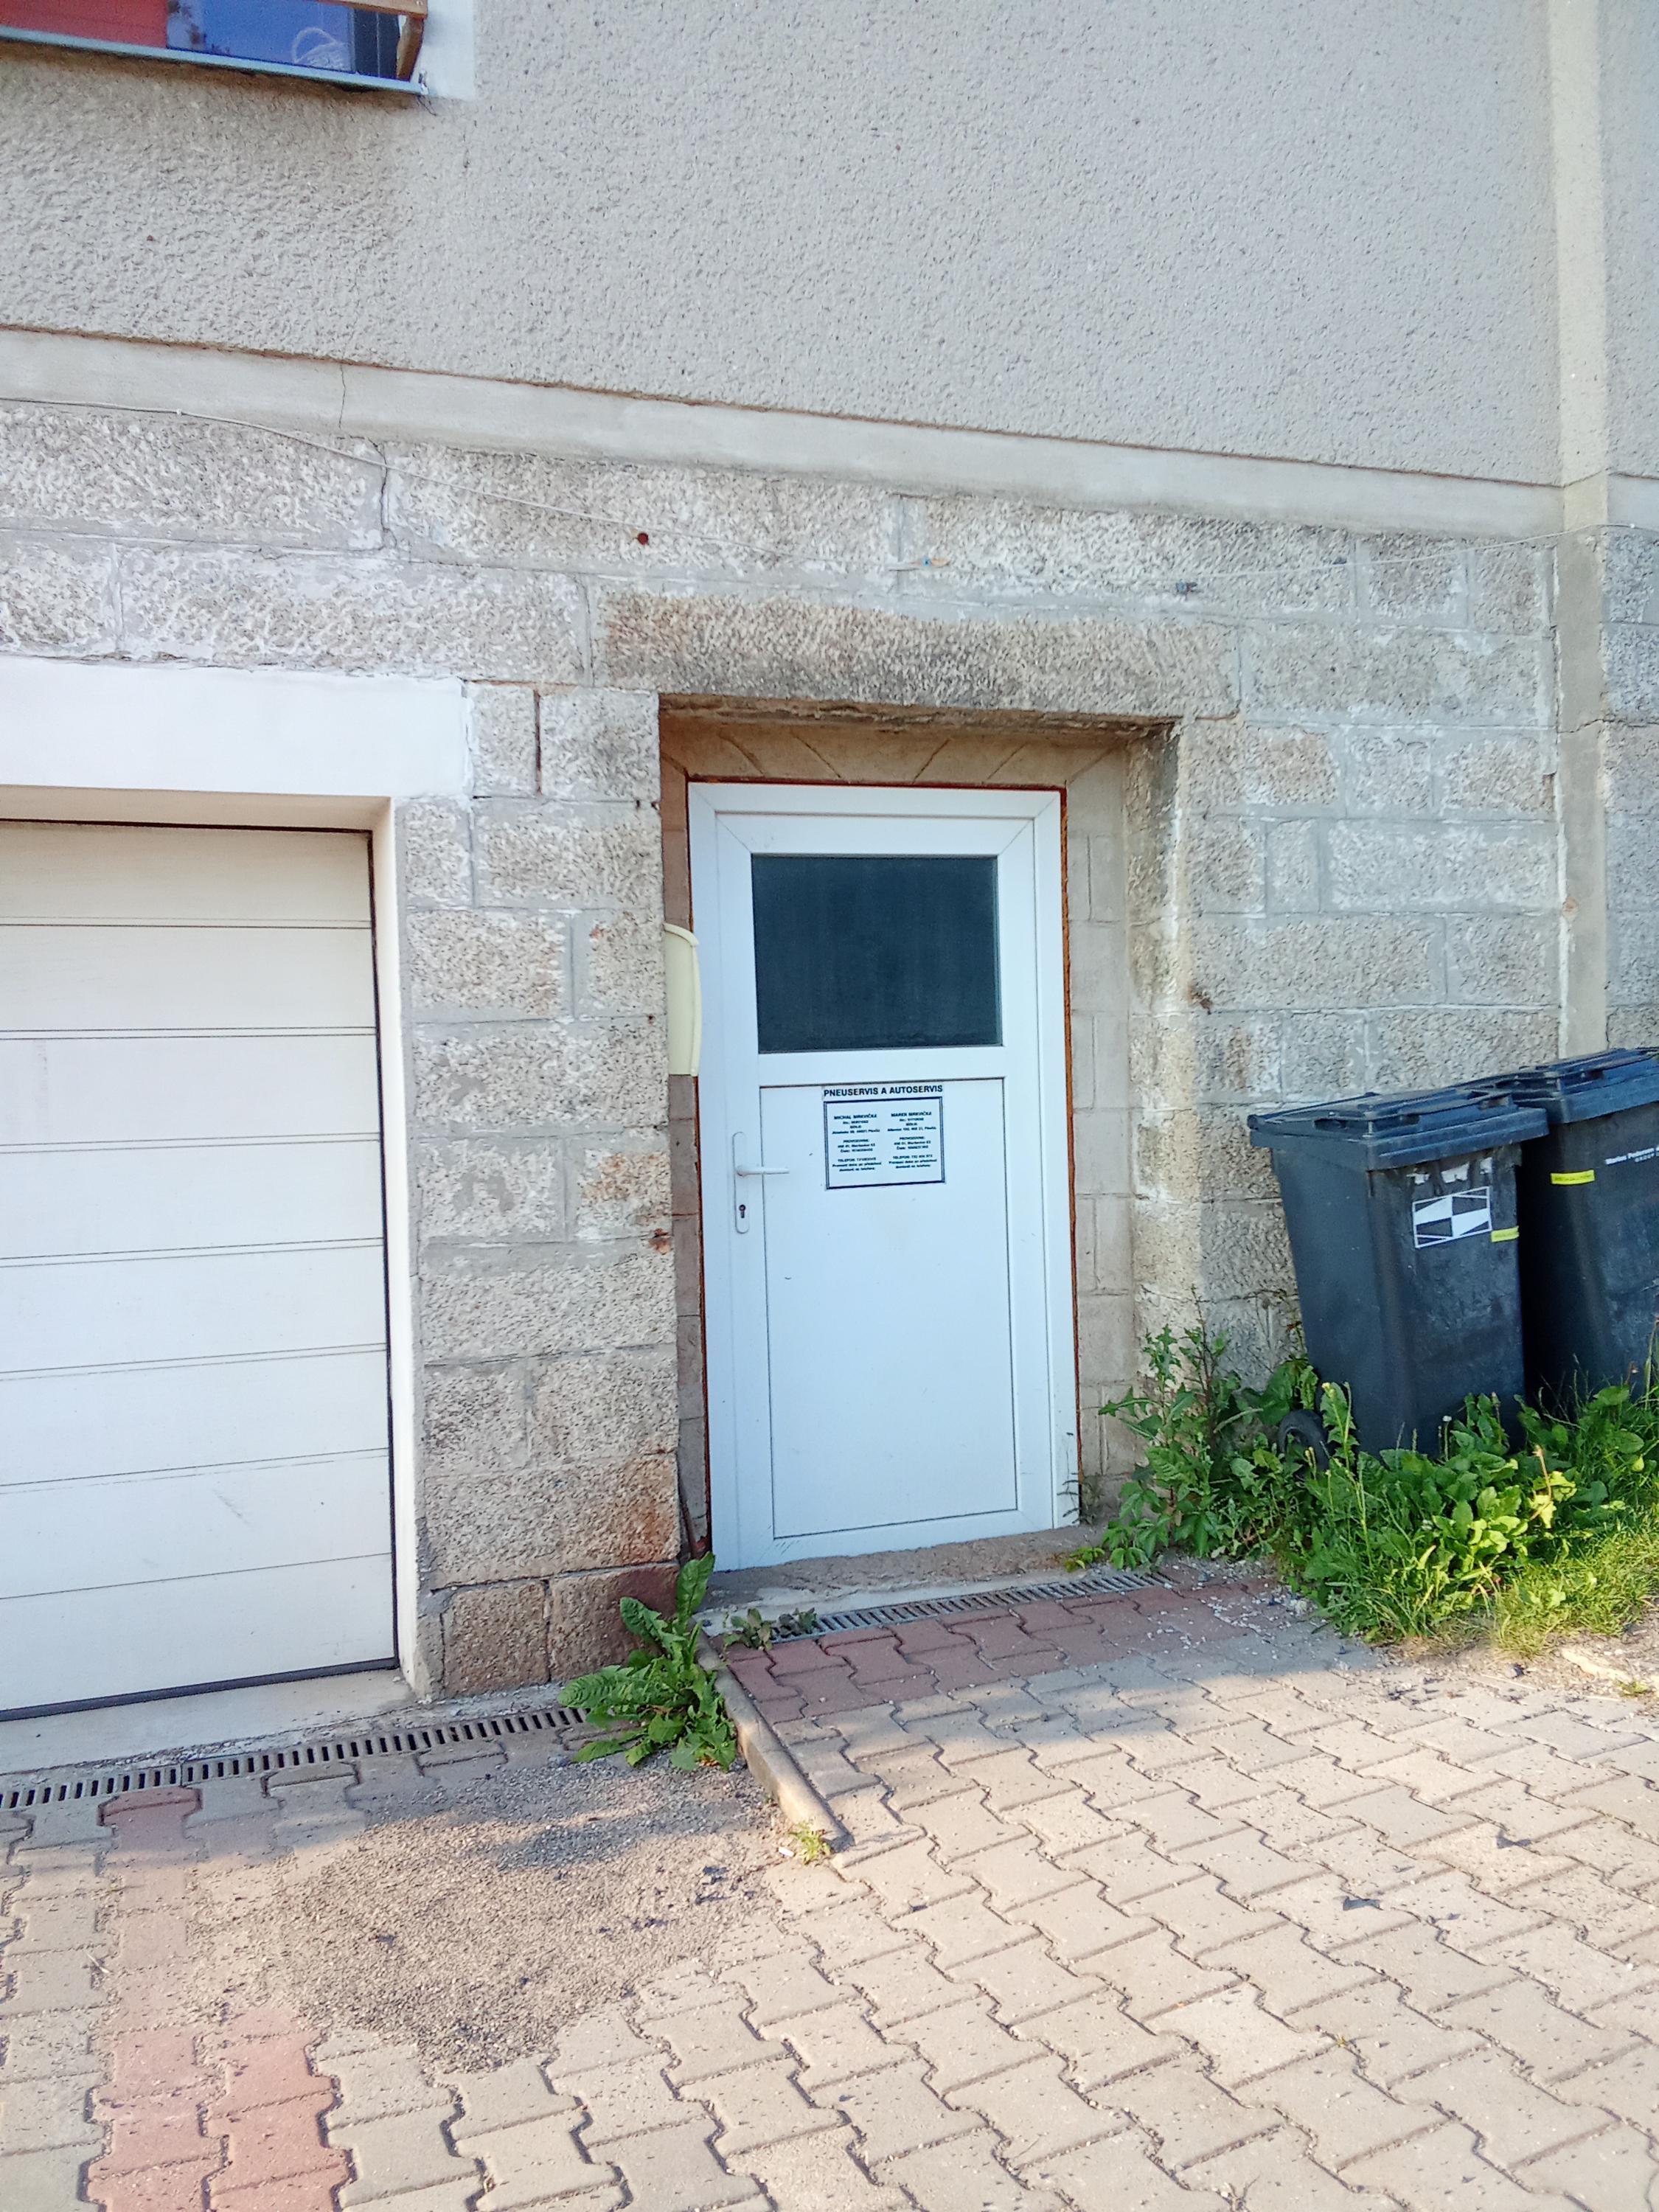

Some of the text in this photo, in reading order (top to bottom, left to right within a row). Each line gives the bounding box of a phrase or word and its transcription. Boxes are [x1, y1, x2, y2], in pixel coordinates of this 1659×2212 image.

[824, 1085, 943, 1097] PNEUSERVIS A AUTOSERVIS
